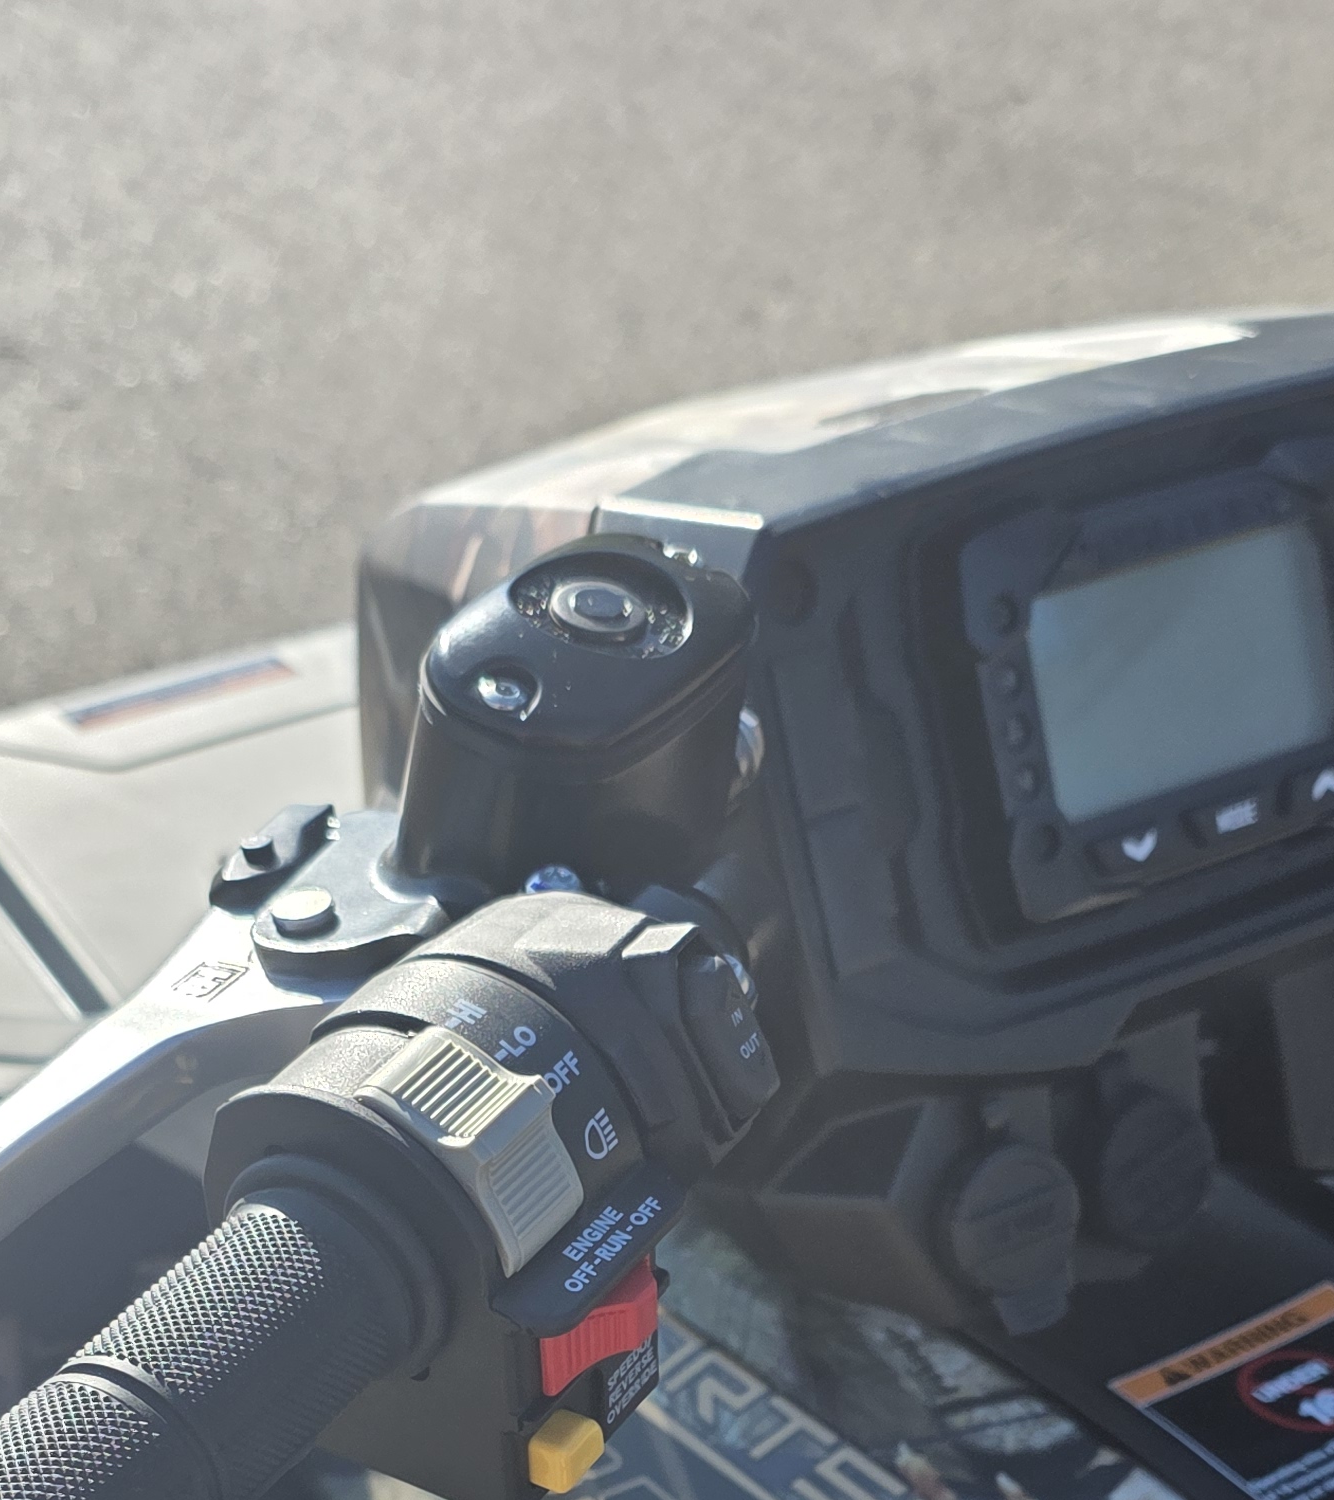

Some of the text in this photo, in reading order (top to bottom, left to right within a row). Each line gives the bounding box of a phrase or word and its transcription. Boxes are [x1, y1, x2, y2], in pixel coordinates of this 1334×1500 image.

[731, 1007, 743, 1027] IN
[740, 1032, 760, 1059] OUT
[544, 1050, 580, 1094] OFF
[562, 1205, 624, 1262] ENGINE
[608, 1345, 654, 1408] REVERSE
